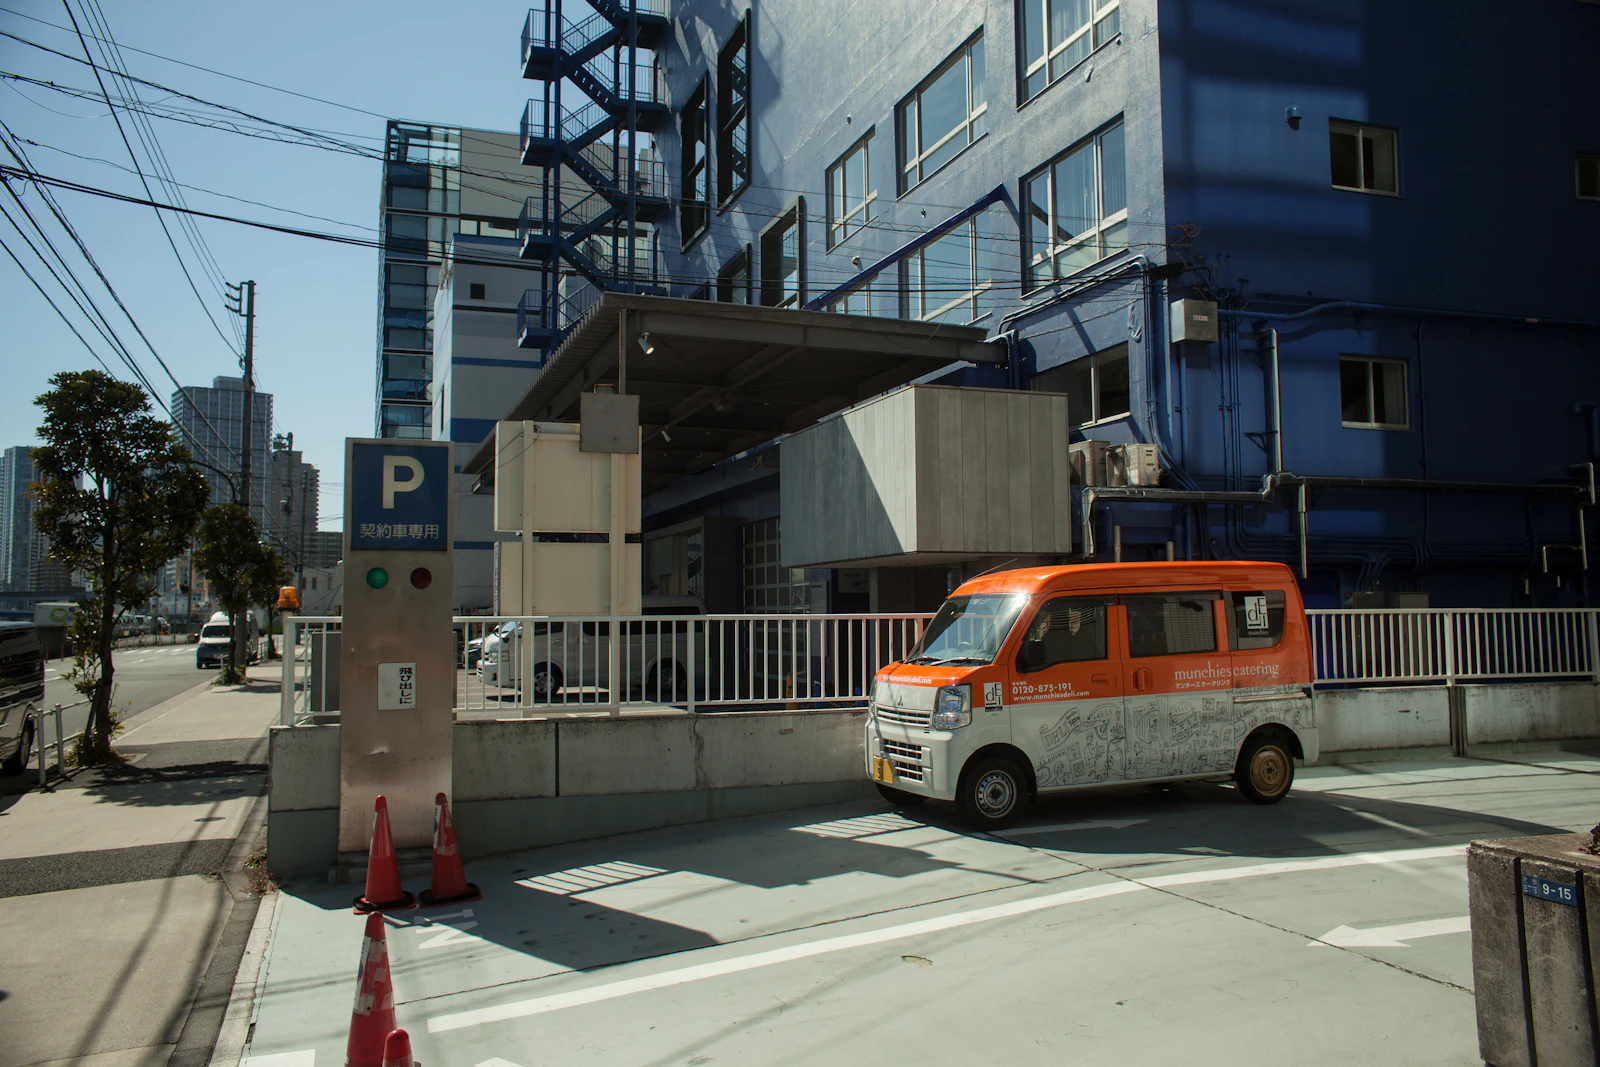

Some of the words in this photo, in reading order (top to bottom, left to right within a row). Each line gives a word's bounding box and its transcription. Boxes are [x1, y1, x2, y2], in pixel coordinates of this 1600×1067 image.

[382, 455, 425, 509] P
[360, 523, 439, 539] 契約車専用
[1174, 660, 1231, 680] munchies
[1233, 661, 1280, 679] catering
[399, 667, 413, 704] 飛び出しに
[1012, 683, 1072, 694] 0120-875-191
[1013, 691, 1090, 701] www.munchiesdeli.com
[1542, 883, 1572, 900] 9-15
[414, 908, 482, 949] IN
